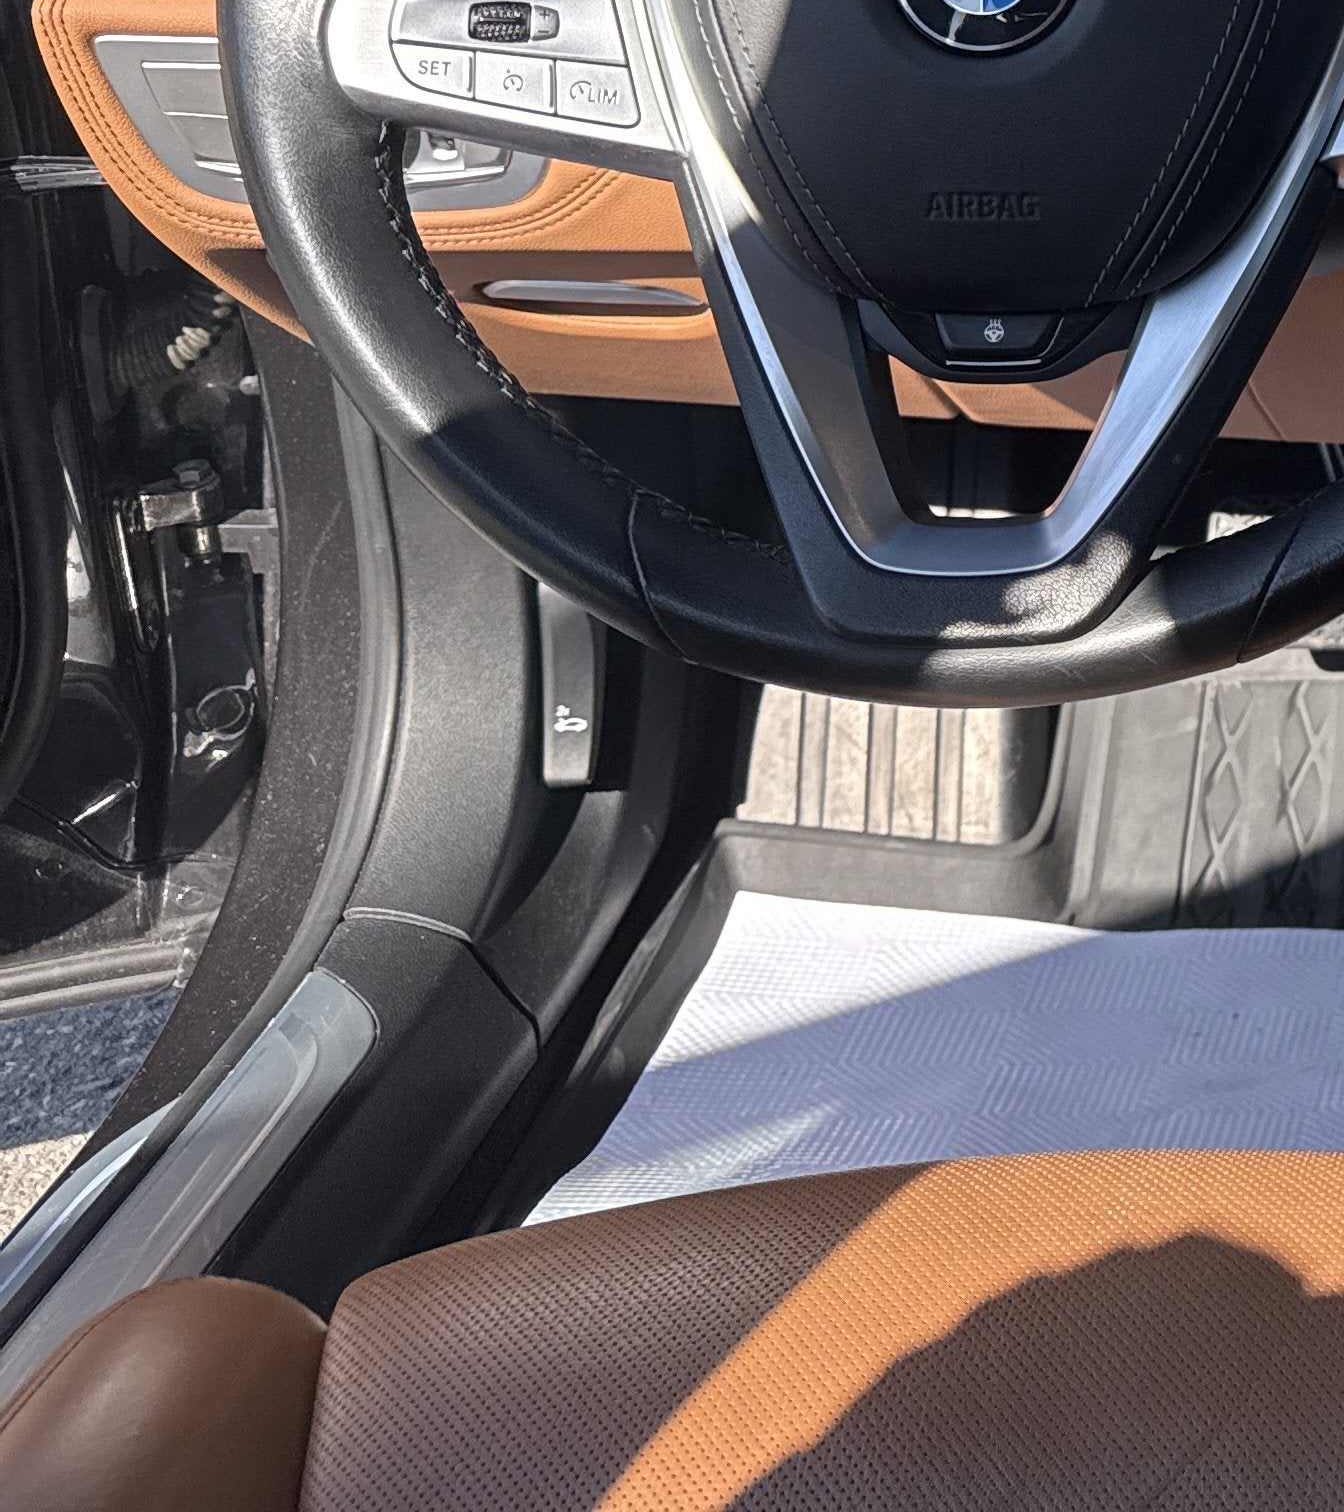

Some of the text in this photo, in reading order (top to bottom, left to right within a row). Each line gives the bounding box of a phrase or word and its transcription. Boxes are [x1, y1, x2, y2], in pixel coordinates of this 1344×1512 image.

[417, 60, 452, 76] SET
[588, 87, 619, 105] LIM
[926, 190, 1041, 221] AIRBAG
